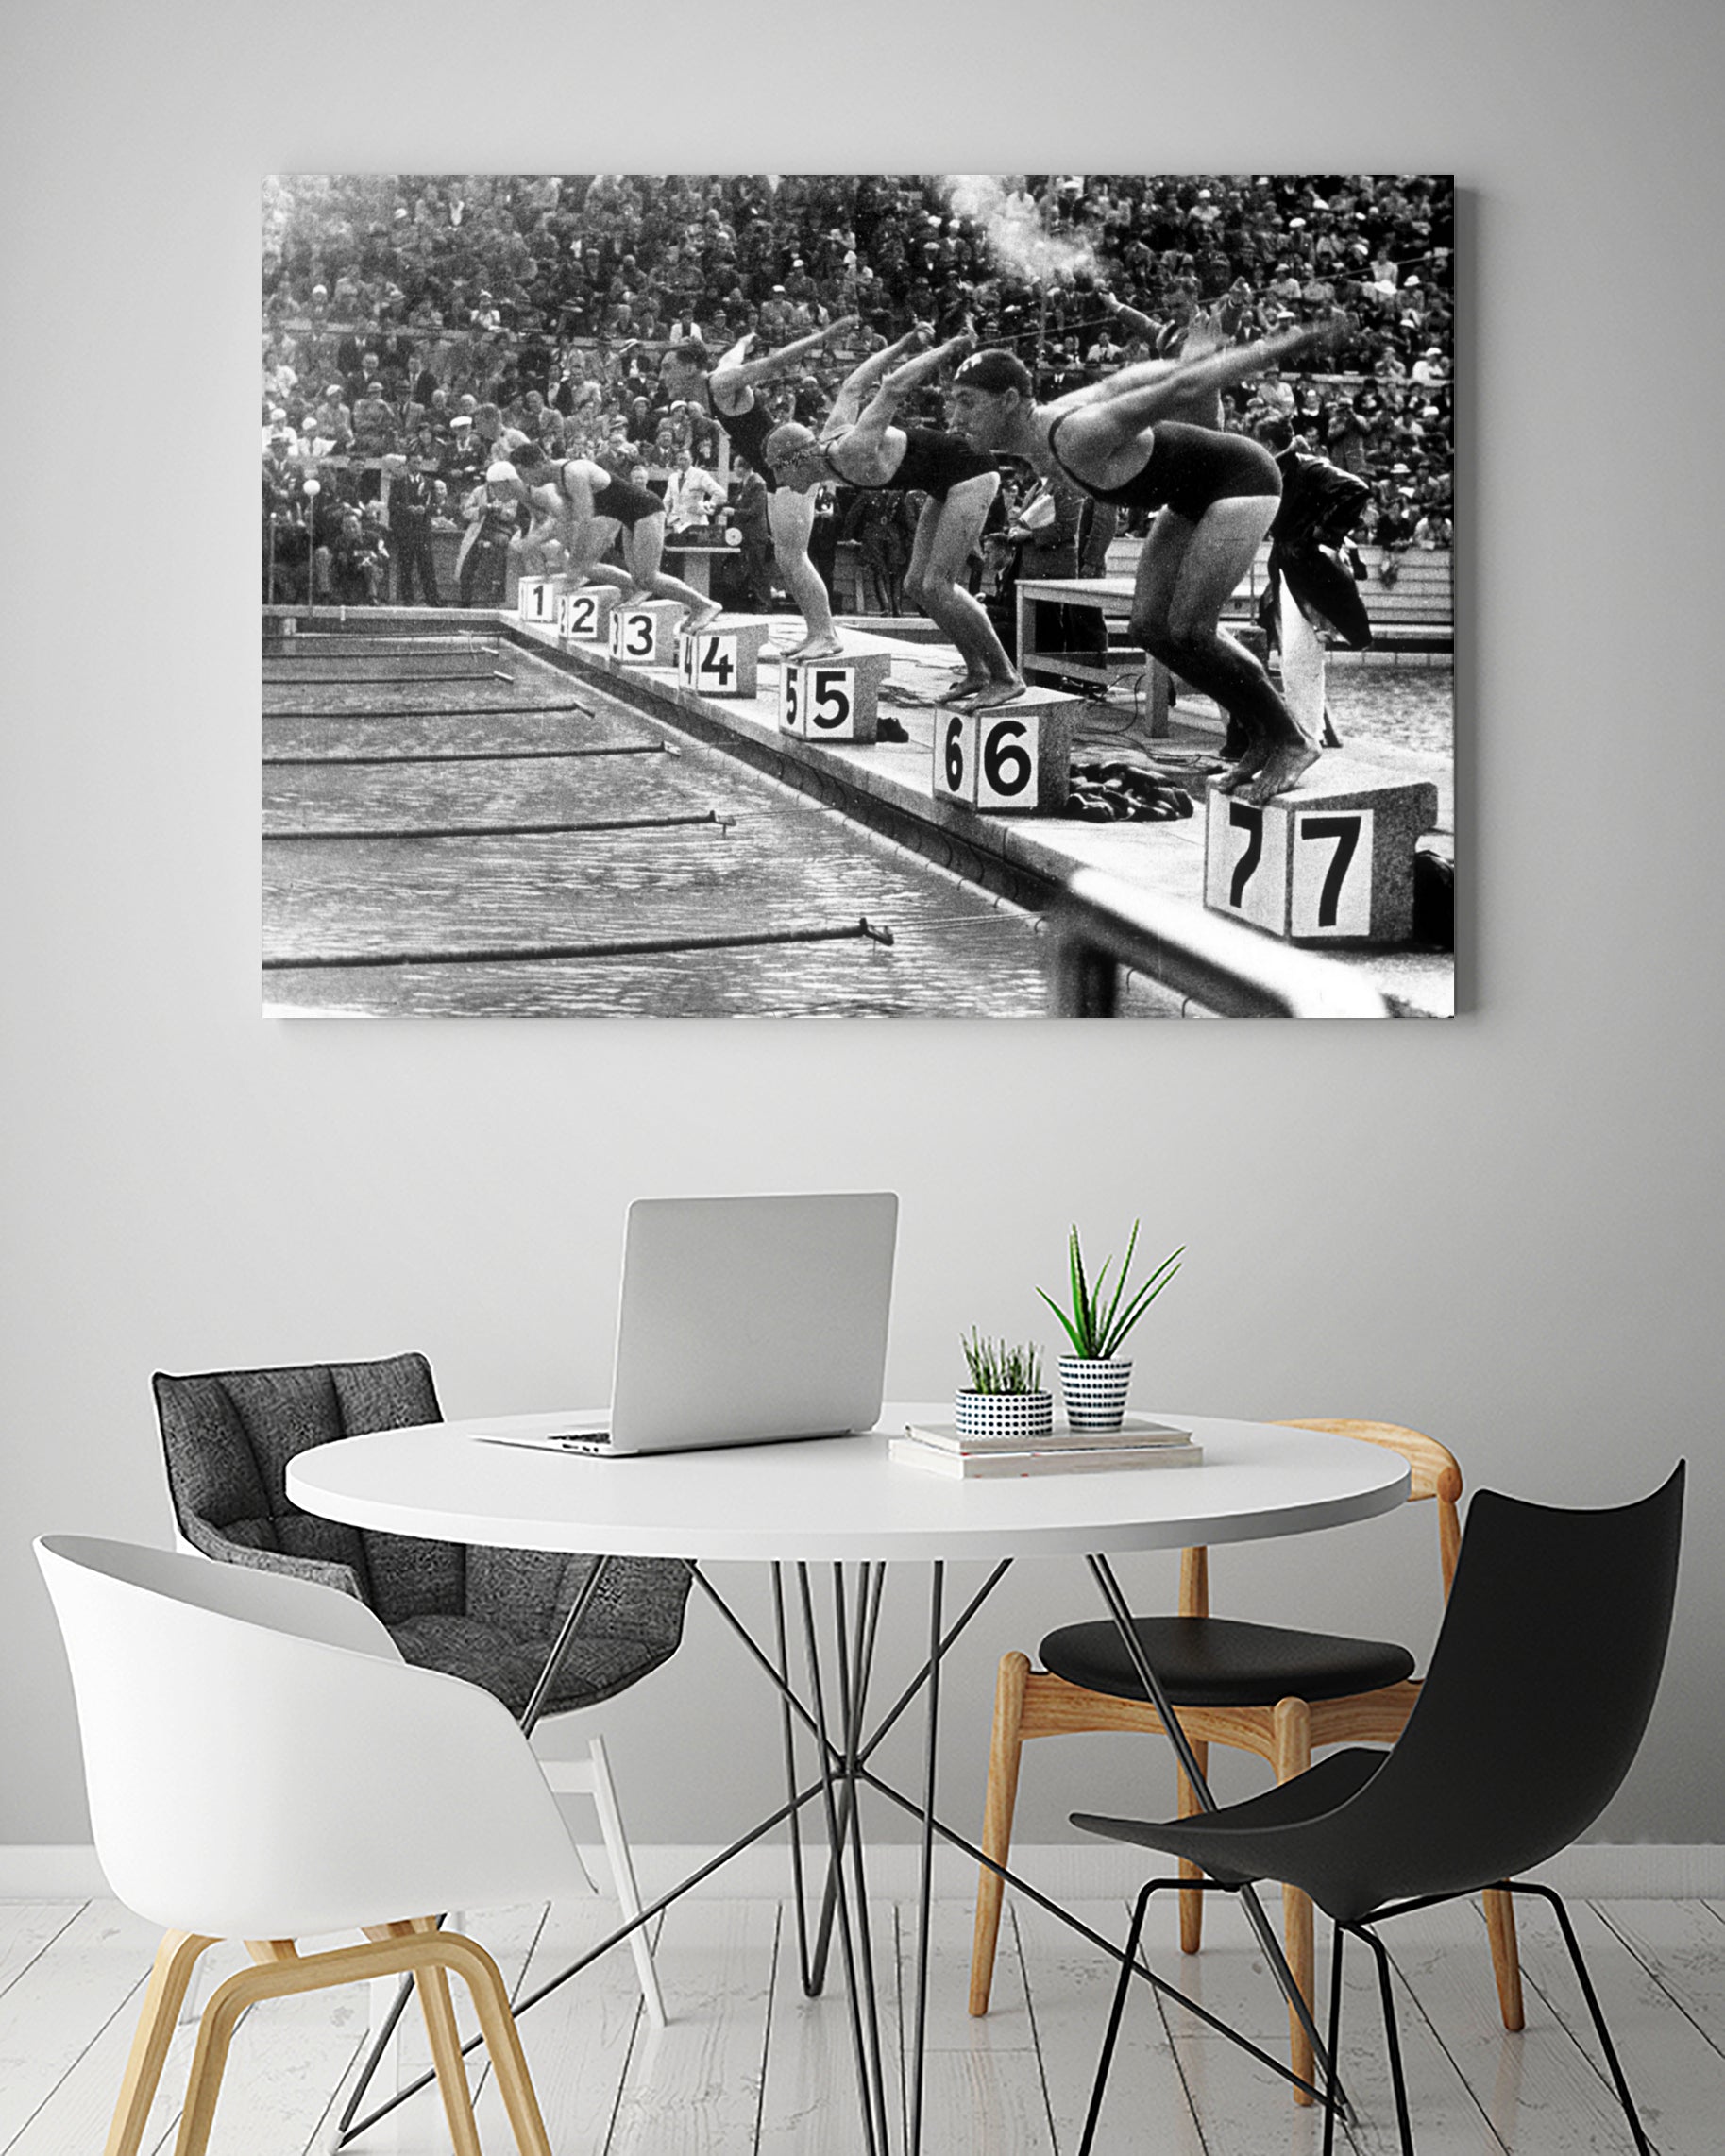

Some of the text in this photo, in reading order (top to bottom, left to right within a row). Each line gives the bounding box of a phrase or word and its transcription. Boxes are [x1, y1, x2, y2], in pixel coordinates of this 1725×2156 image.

[533, 585, 544, 616] 1
[572, 598, 595, 632] 2
[627, 615, 653, 655] 3
[701, 637, 734, 685] 4
[786, 668, 798, 725] 5
[813, 671, 850, 729] 5
[945, 717, 963, 792] 6
[984, 721, 1031, 796] 6
[1229, 802, 1263, 908] 7
[1301, 816, 1361, 927] 7
